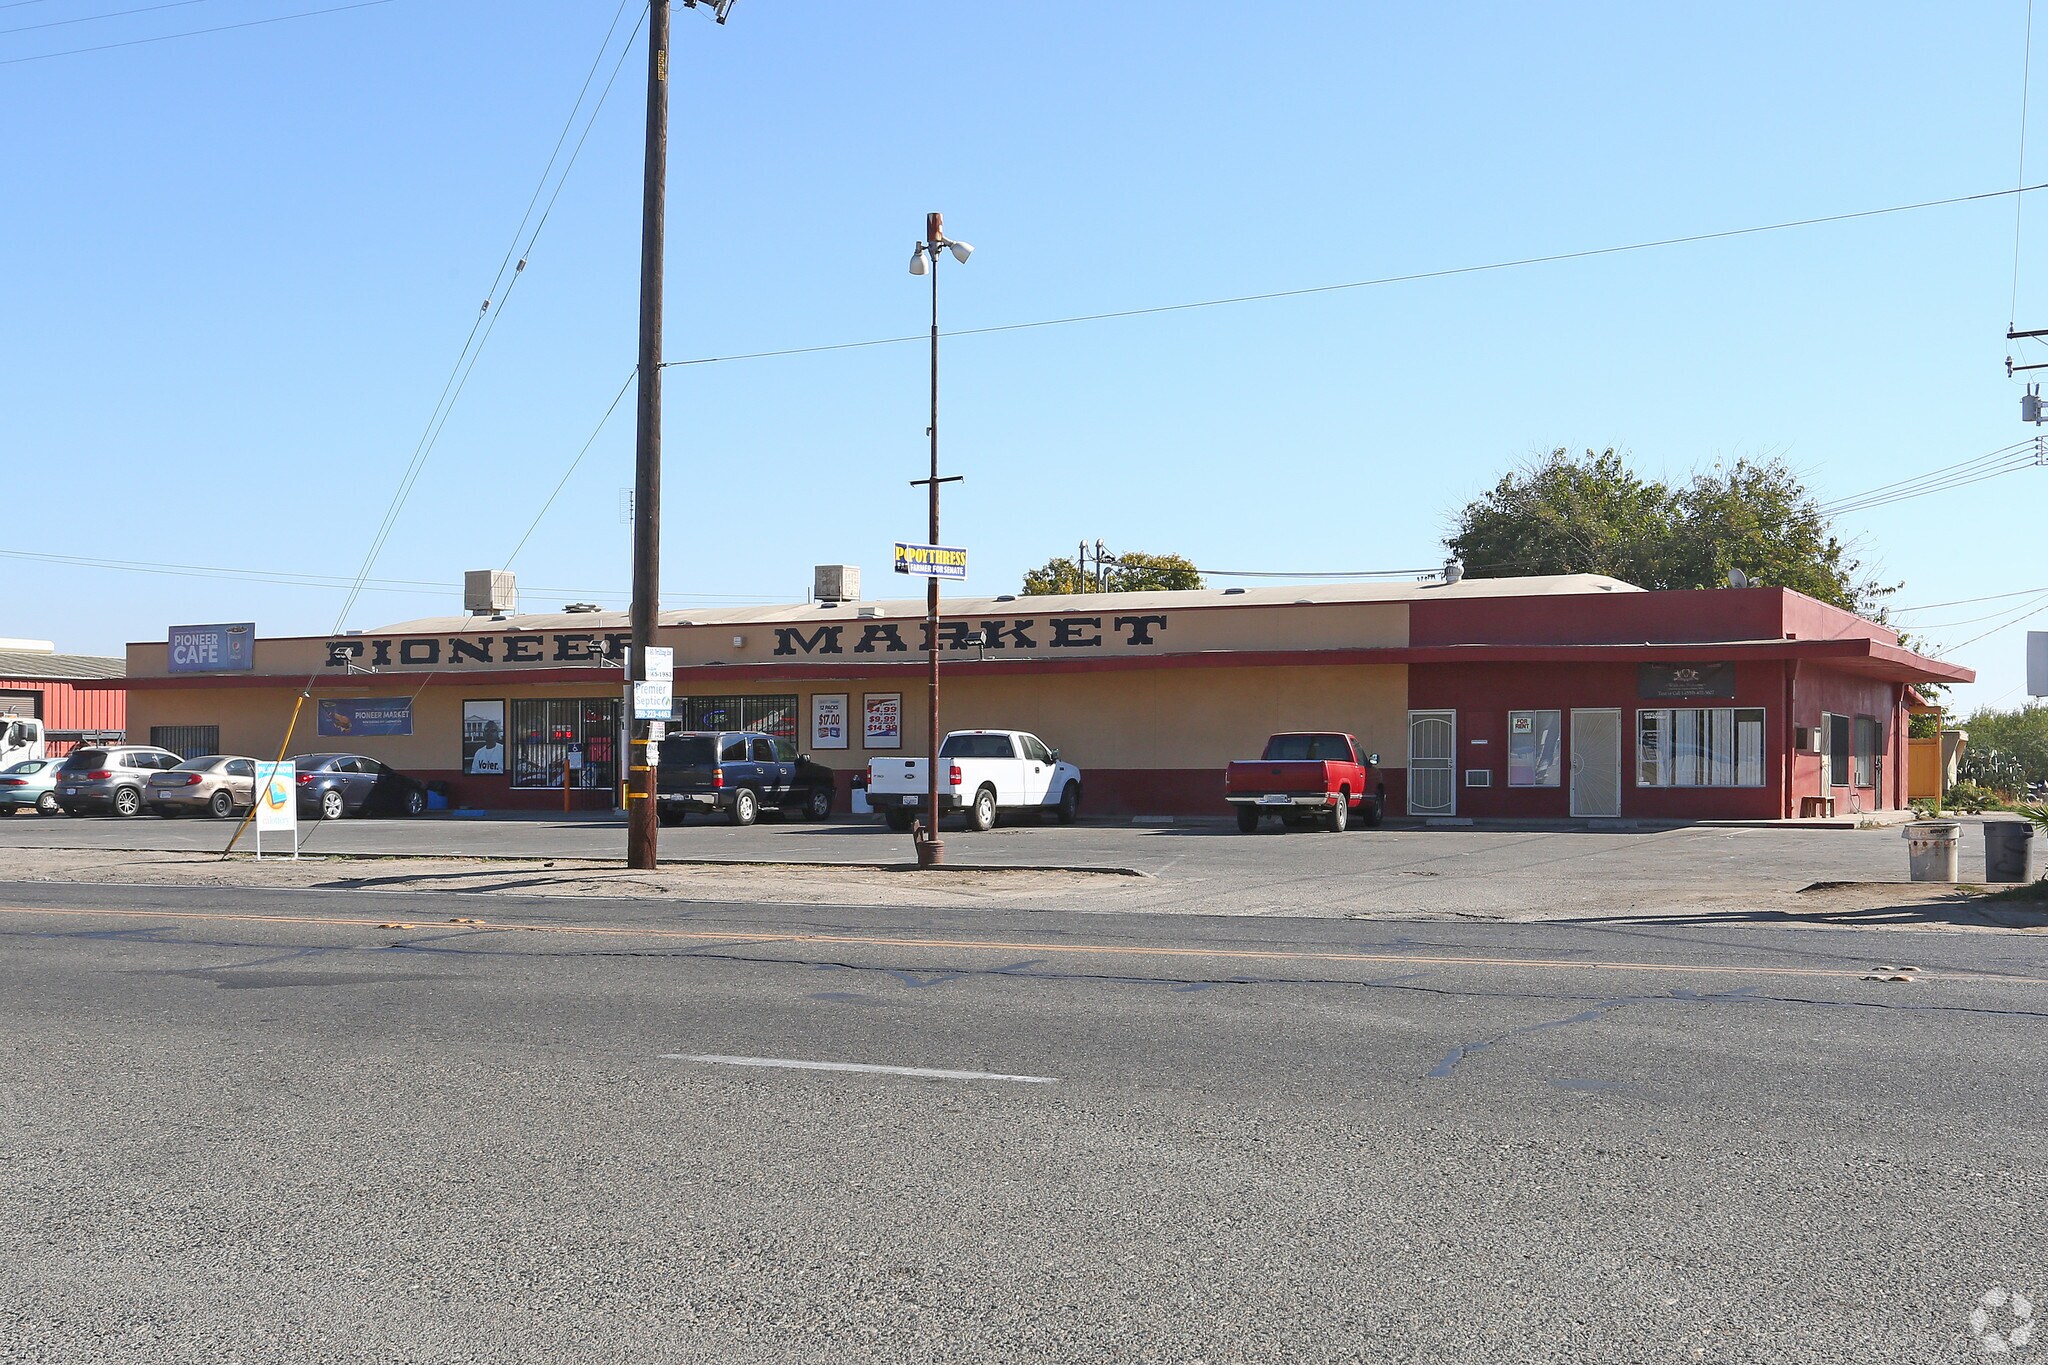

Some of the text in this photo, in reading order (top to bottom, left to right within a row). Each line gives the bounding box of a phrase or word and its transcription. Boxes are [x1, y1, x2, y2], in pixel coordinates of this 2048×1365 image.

[909, 548, 966, 566] POYTHRESS
[911, 563, 964, 575] FARMER FOR SENATE
[174, 633, 218, 646] PIONEER
[773, 615, 1167, 656] MARKET
[173, 645, 218, 664] CAFE
[635, 683, 666, 694] Premier
[636, 696, 661, 707] Septic
[355, 710, 410, 719] PIONEER MARKET
[819, 713, 840, 726] $17.00
